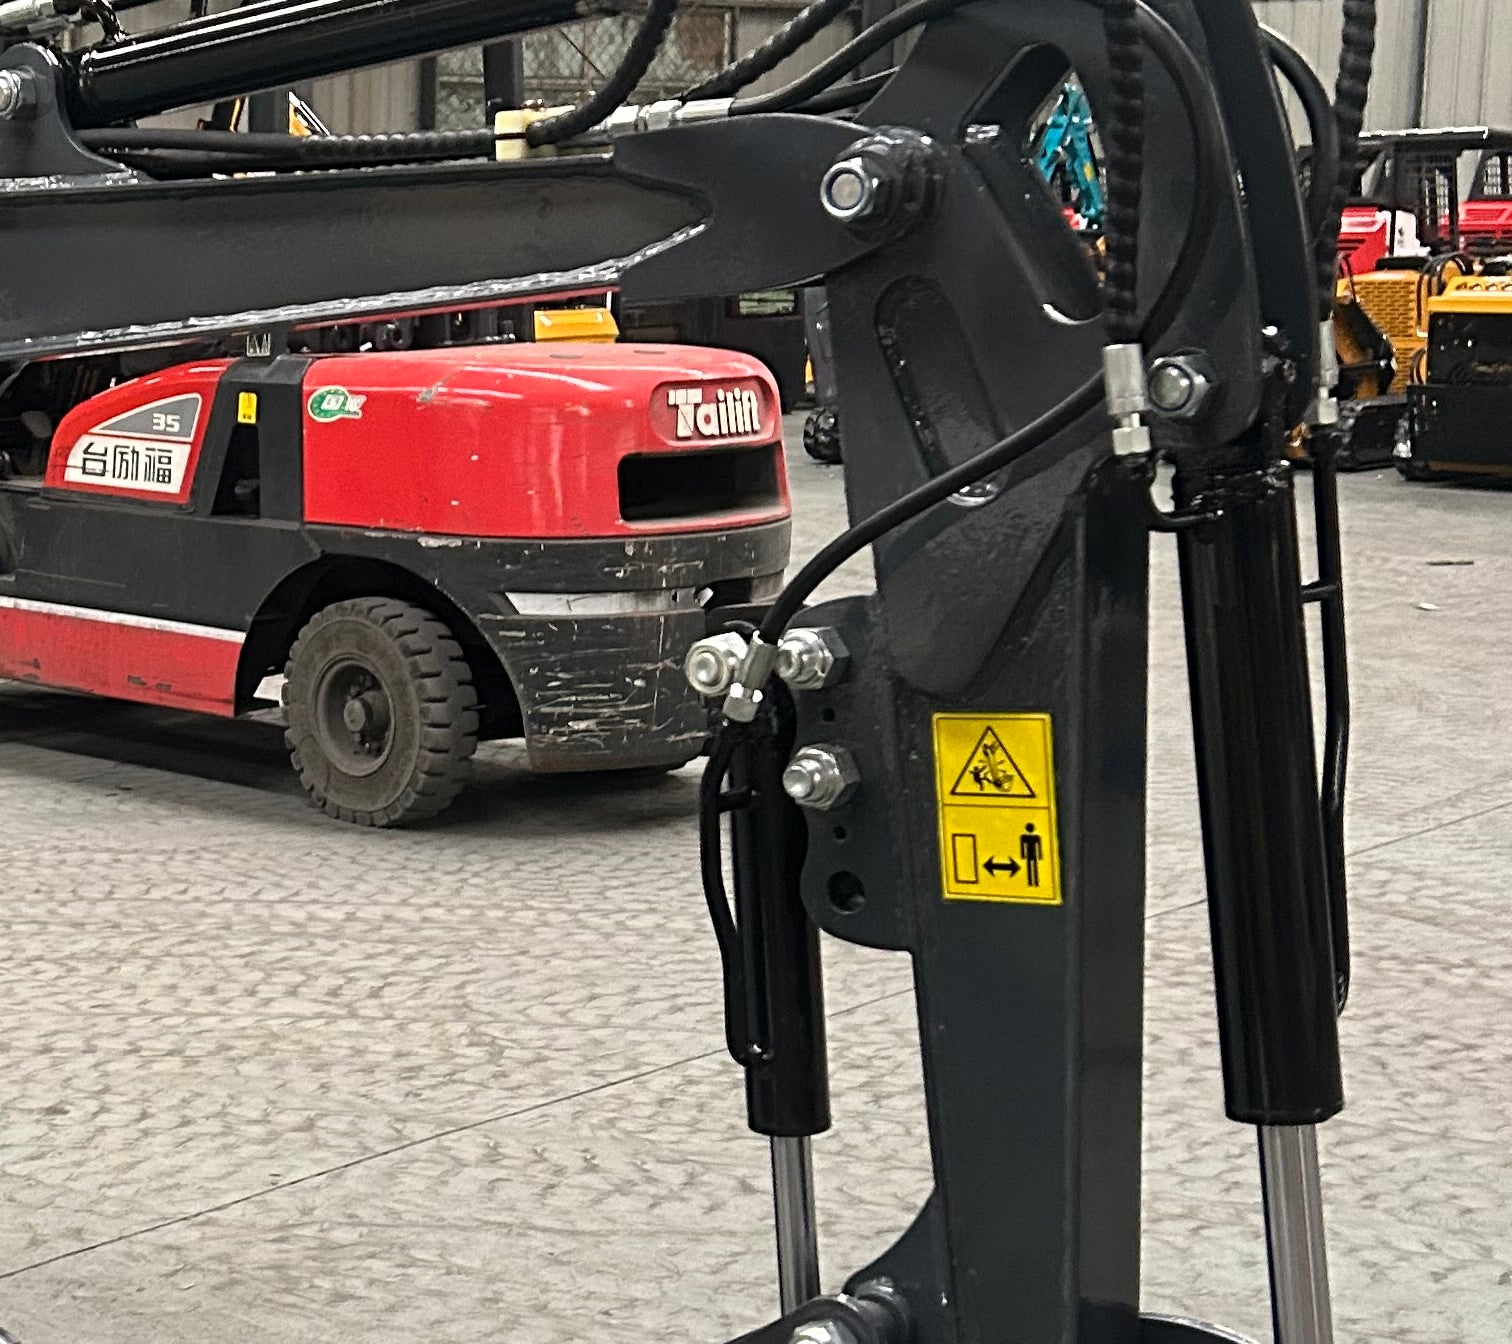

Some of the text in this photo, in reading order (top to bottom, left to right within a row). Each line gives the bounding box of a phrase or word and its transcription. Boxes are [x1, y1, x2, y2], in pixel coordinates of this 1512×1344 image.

[153, 413, 181, 432] 35
[667, 387, 761, 437] Tailift
[82, 442, 173, 484] 台励福
